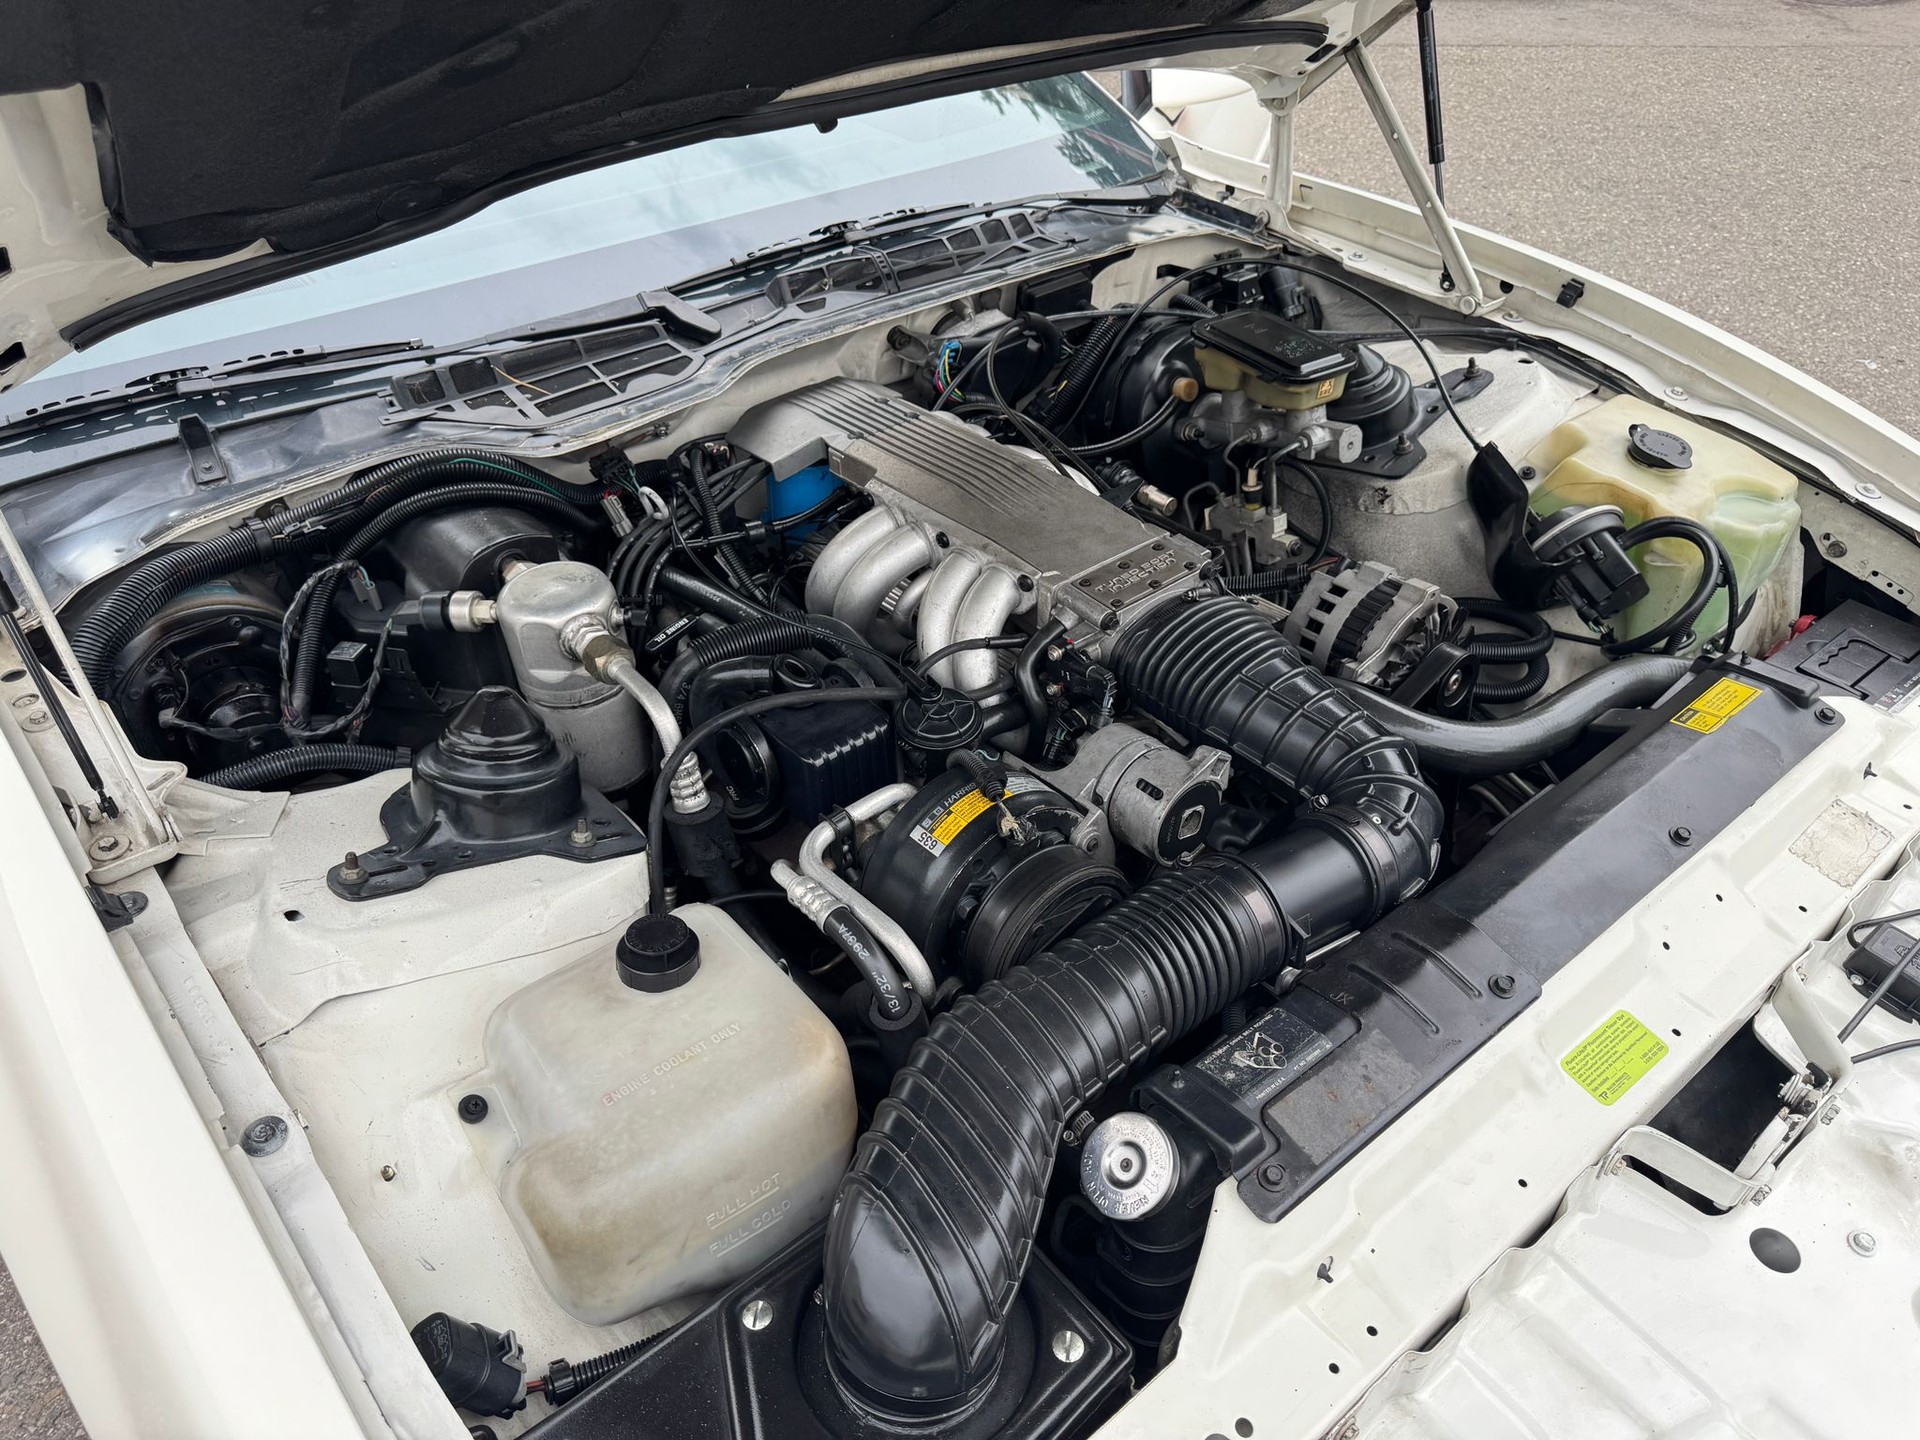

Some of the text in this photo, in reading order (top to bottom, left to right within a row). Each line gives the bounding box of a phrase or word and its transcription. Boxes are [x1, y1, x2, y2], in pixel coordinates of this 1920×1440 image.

[1095, 549, 1175, 592] TUNED PORT
[1108, 557, 1176, 593] INJECTION
[654, 618, 689, 643] ENGINE OIL
[919, 831, 938, 850] 635
[1243, 1026, 1254, 1037] BELT
[1253, 1013, 1273, 1029] ROUTING
[602, 1022, 741, 1107] ENGINE COOLANT ONLY
[706, 1172, 780, 1227] FULL HOT
[1114, 1194, 1149, 1214] NEVER
[709, 1200, 791, 1254] FULL COLD
